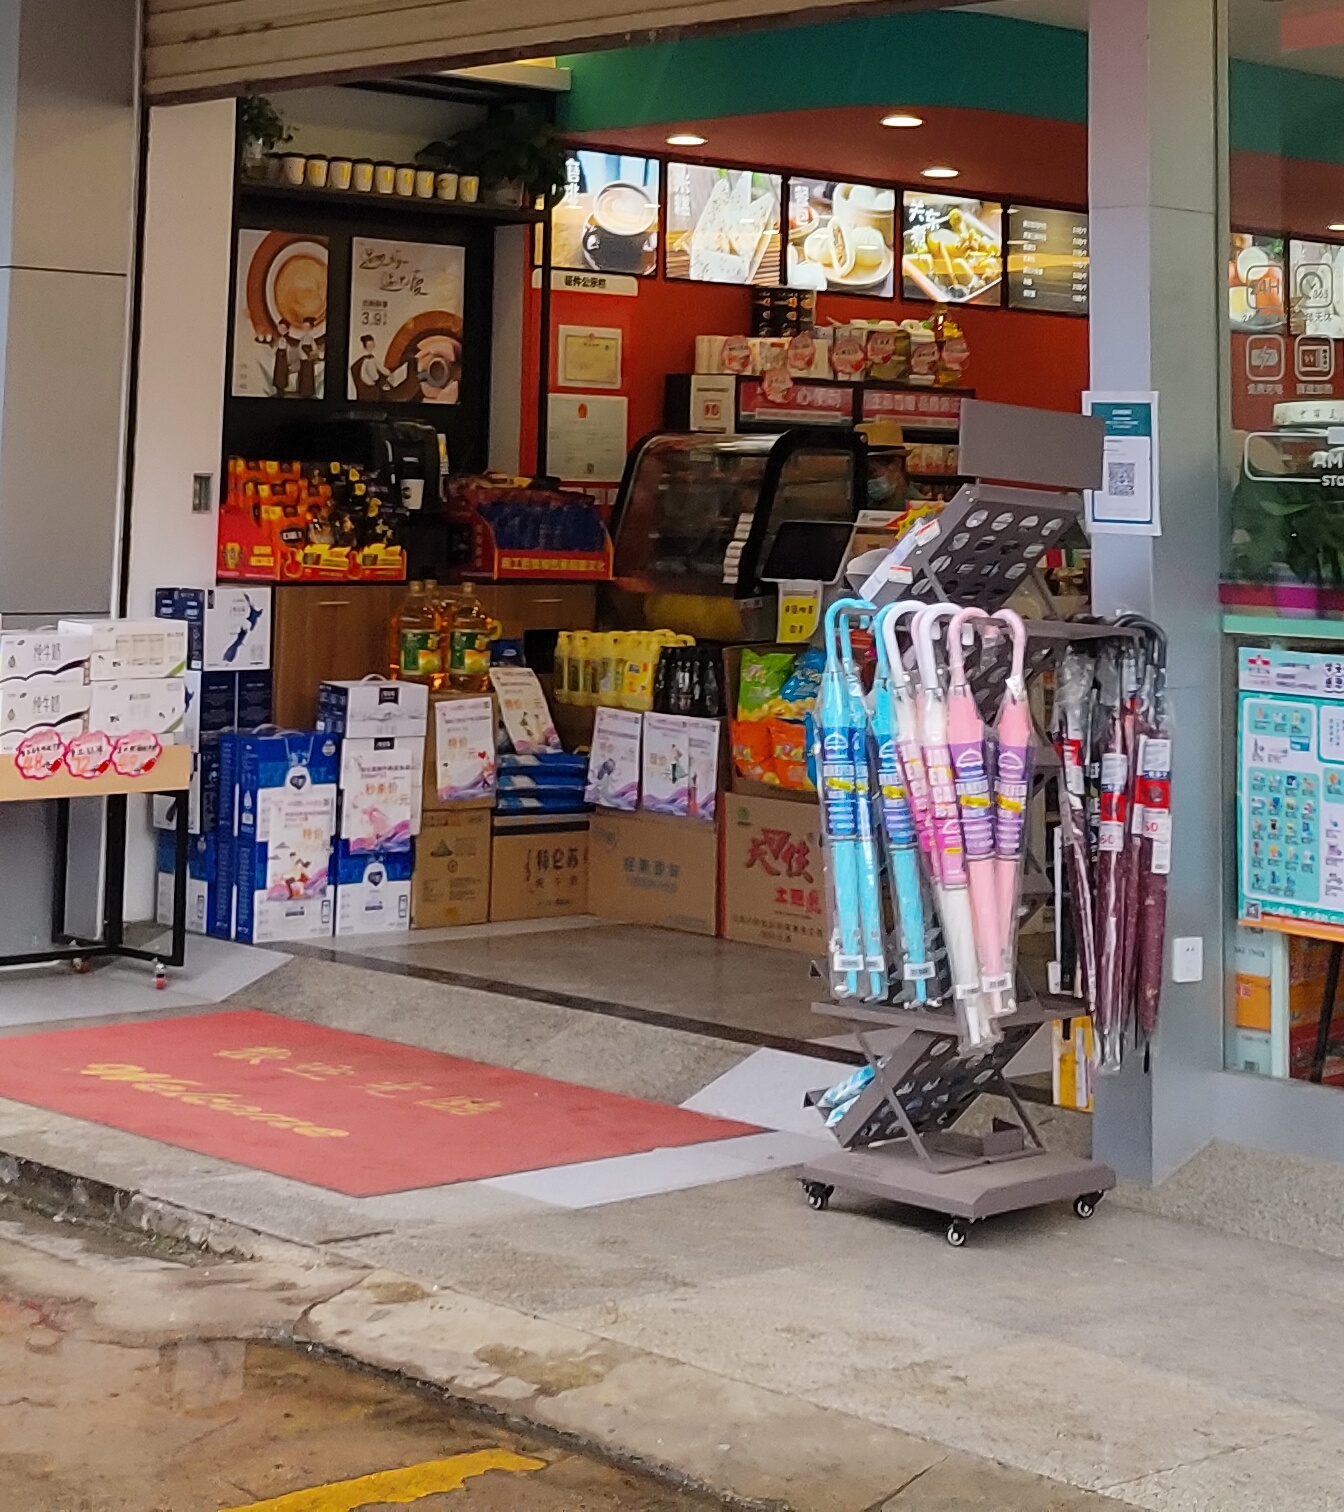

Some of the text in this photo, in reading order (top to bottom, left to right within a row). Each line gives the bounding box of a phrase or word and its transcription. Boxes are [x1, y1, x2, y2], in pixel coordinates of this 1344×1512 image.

[1313, 454, 1344, 469] AM
[32, 643, 62, 661] 纯牛奶
[32, 694, 61, 713] 纯牛奶
[80, 1062, 351, 1139] Welcome
